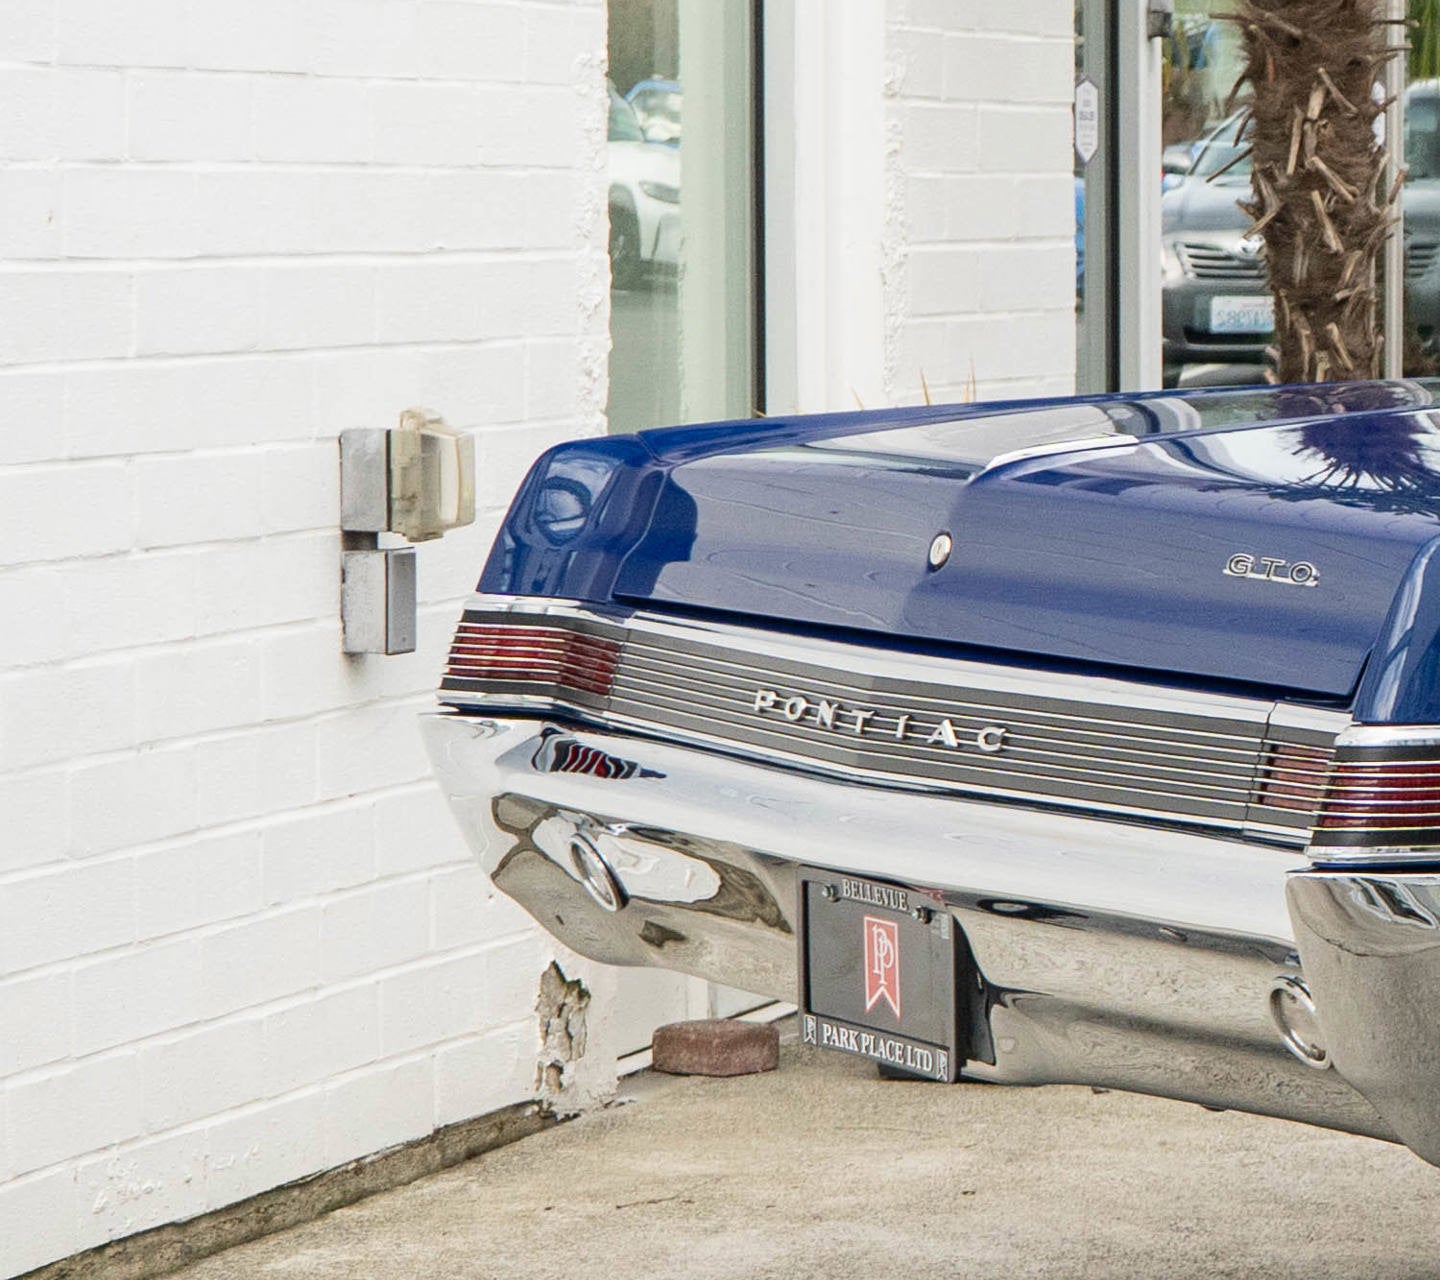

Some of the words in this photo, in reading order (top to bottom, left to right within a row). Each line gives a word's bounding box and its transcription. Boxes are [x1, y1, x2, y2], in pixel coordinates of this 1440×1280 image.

[1224, 552, 1320, 586] GTO
[754, 689, 1006, 751] PONTIAC
[842, 878, 908, 911] BELLEVUE
[822, 1023, 859, 1052] PARK
[860, 1032, 904, 1063] PLACE
[906, 1045, 933, 1072] LTD
